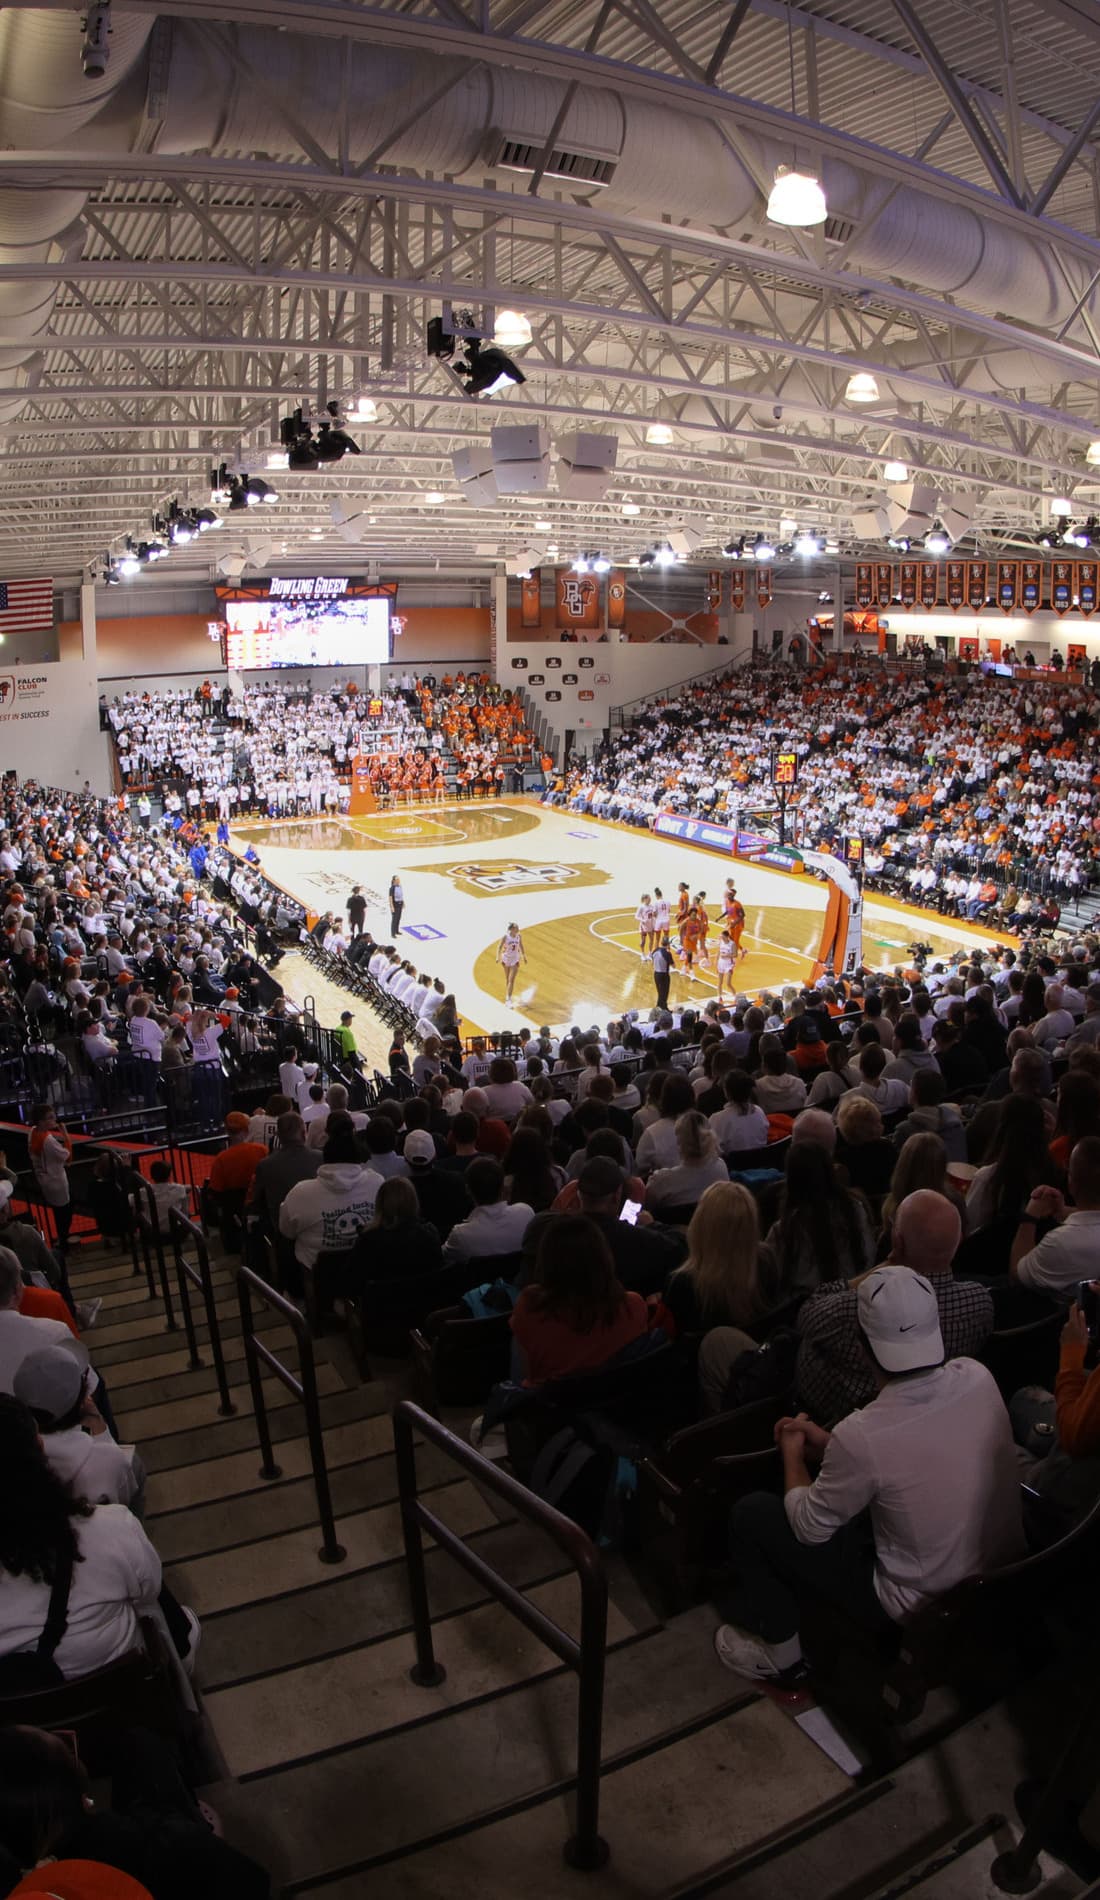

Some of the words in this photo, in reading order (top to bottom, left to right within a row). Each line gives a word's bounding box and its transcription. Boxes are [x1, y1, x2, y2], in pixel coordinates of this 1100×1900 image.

[269, 577, 315, 595] BOWLING
[314, 576, 349, 594] GREEN
[17, 677, 47, 685] FALCON
[20, 710, 50, 720] SUCCESS
[776, 765, 793, 782] 20
